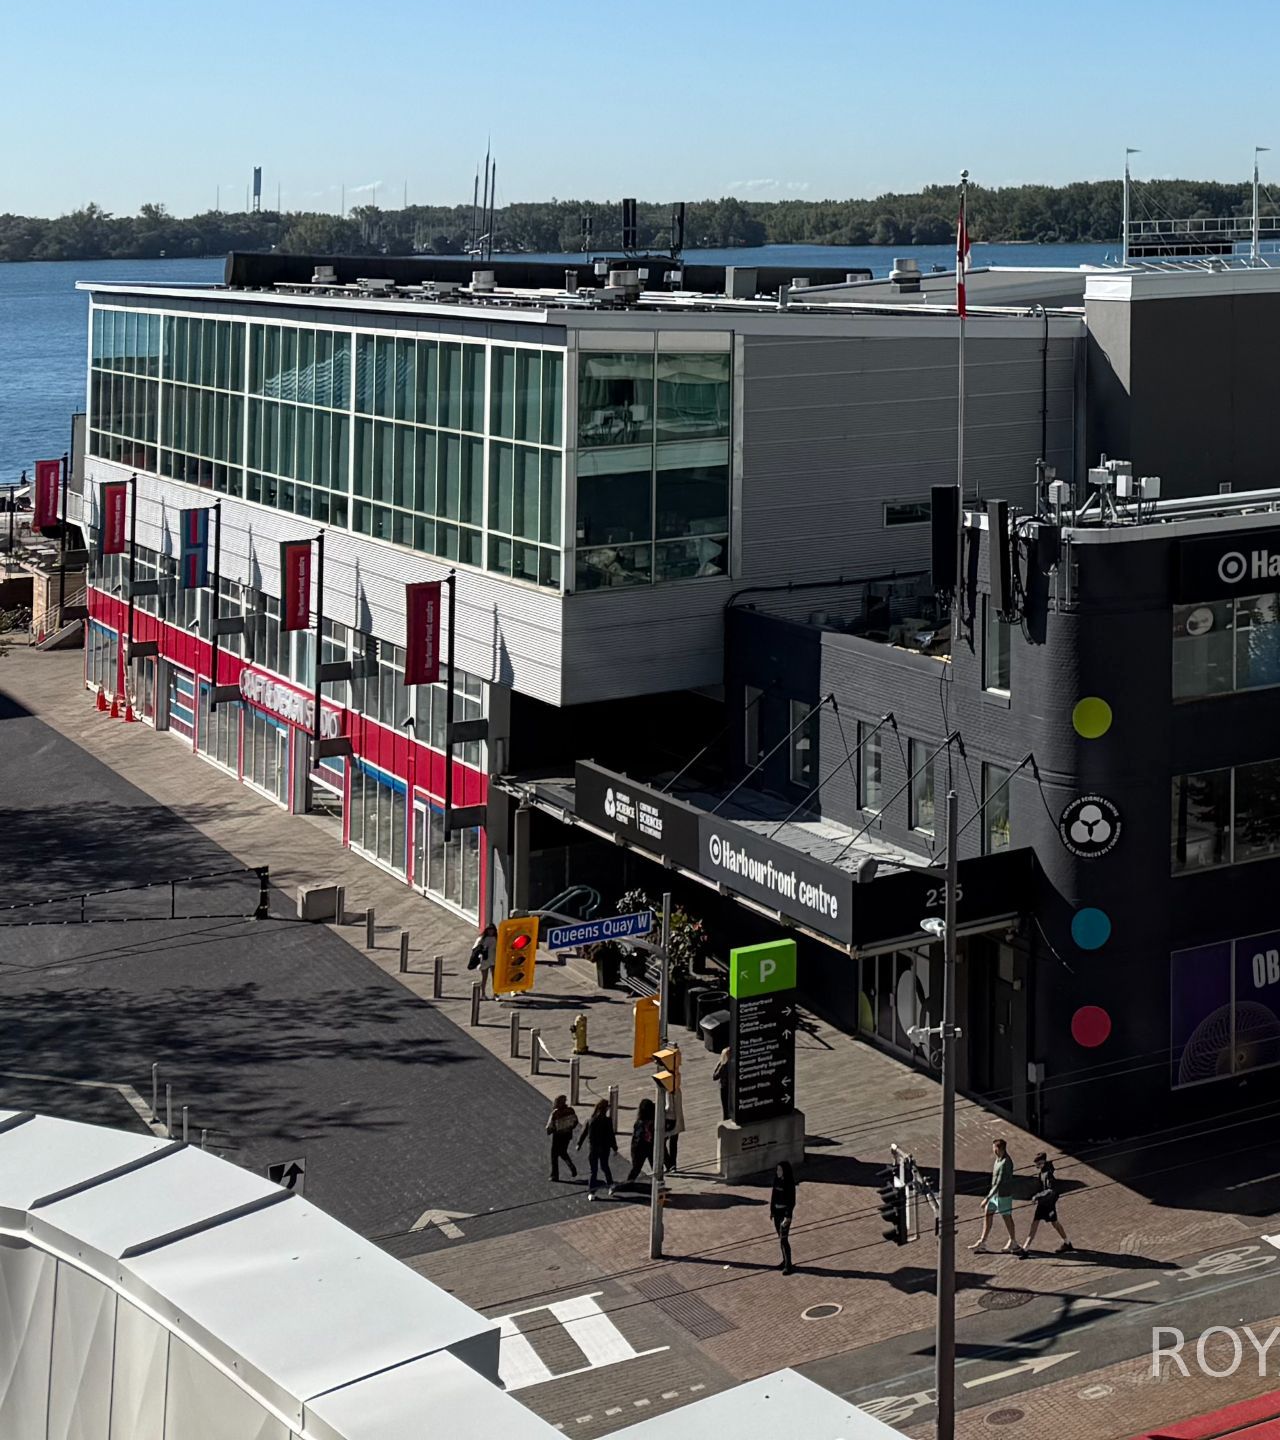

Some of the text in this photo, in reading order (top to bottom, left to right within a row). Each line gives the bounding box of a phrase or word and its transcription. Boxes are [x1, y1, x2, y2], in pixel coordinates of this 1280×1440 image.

[305, 699, 339, 739] STDIO
[721, 839, 838, 919] Harbourfront centre
[552, 913, 648, 945] Queens Quay W
[760, 959, 776, 983] P
